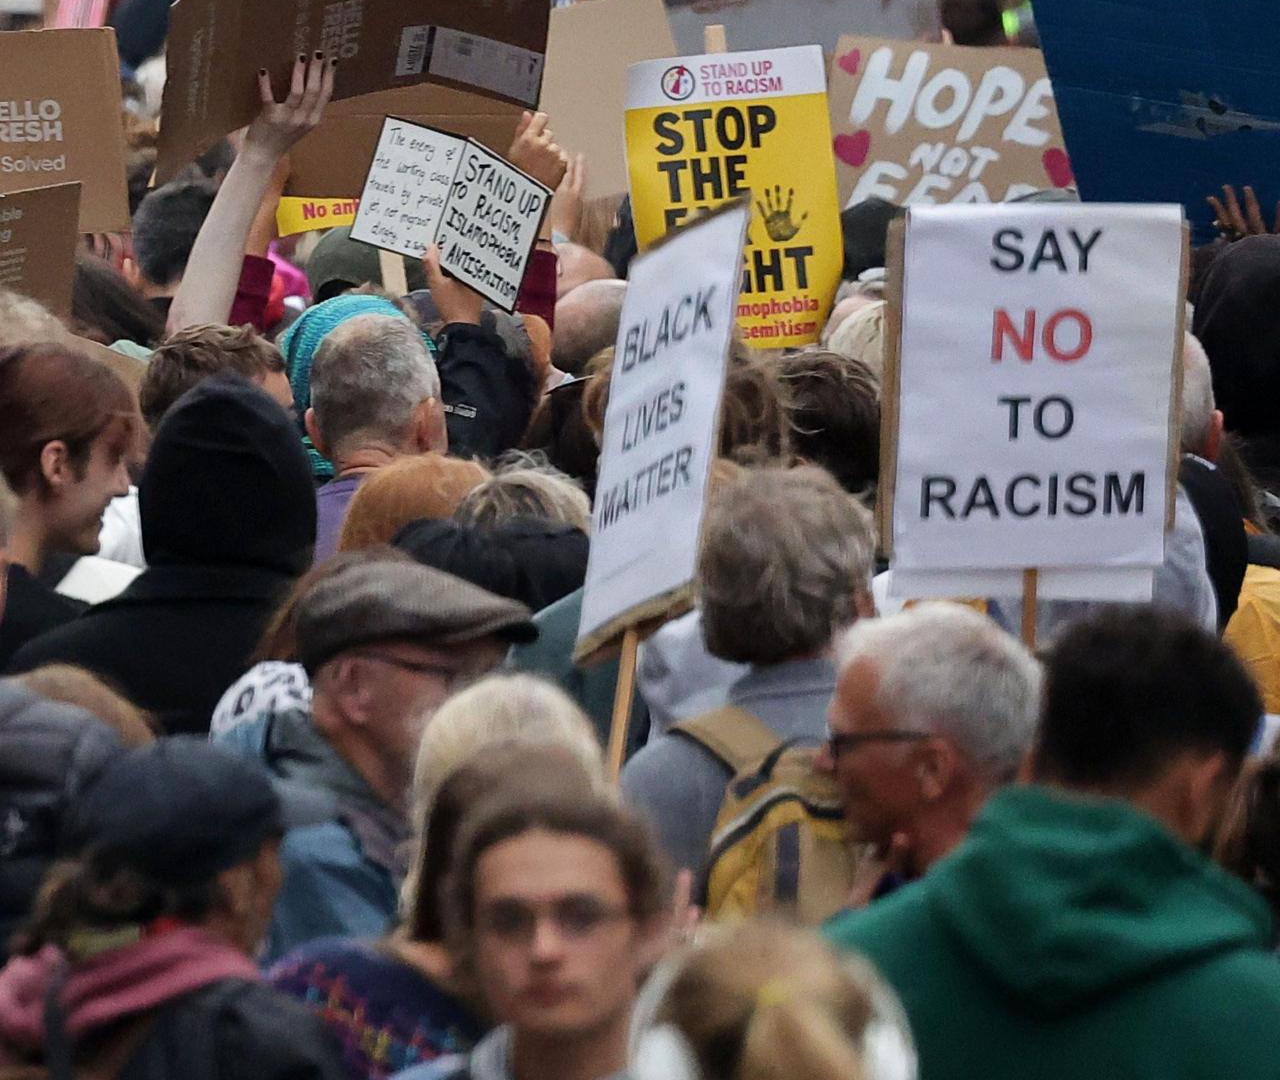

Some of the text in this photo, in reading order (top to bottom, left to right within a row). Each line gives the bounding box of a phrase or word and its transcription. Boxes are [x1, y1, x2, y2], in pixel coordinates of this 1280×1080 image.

[700, 60, 773, 80] STAND UP
[702, 76, 784, 97] TO RACISM
[849, 46, 1053, 146] HOPE
[390, 127, 406, 146] The
[409, 139, 436, 162] enemy
[653, 105, 778, 157] STOP
[1, 155, 66, 172] Solved
[376, 151, 391, 169] the
[396, 161, 426, 186] working
[657, 155, 750, 204] THE
[909, 143, 1001, 180] NOT
[400, 187, 412, 206] by
[465, 154, 541, 219] STAND UP
[302, 202, 327, 220] No
[452, 180, 523, 245] TO RACISM,
[446, 206, 523, 272] ISLAMOPHOBIA
[990, 227, 1104, 273] SAY
[446, 242, 518, 302] ANTISEMITISM
[620, 285, 716, 375] BLACK
[736, 297, 819, 319] mophobia
[742, 320, 818, 340] semitism
[990, 307, 1093, 364] NO
[620, 380, 688, 455] LIVES
[997, 394, 1074, 440] TO
[597, 445, 694, 535] MATTER
[919, 471, 1146, 519] RACISM
